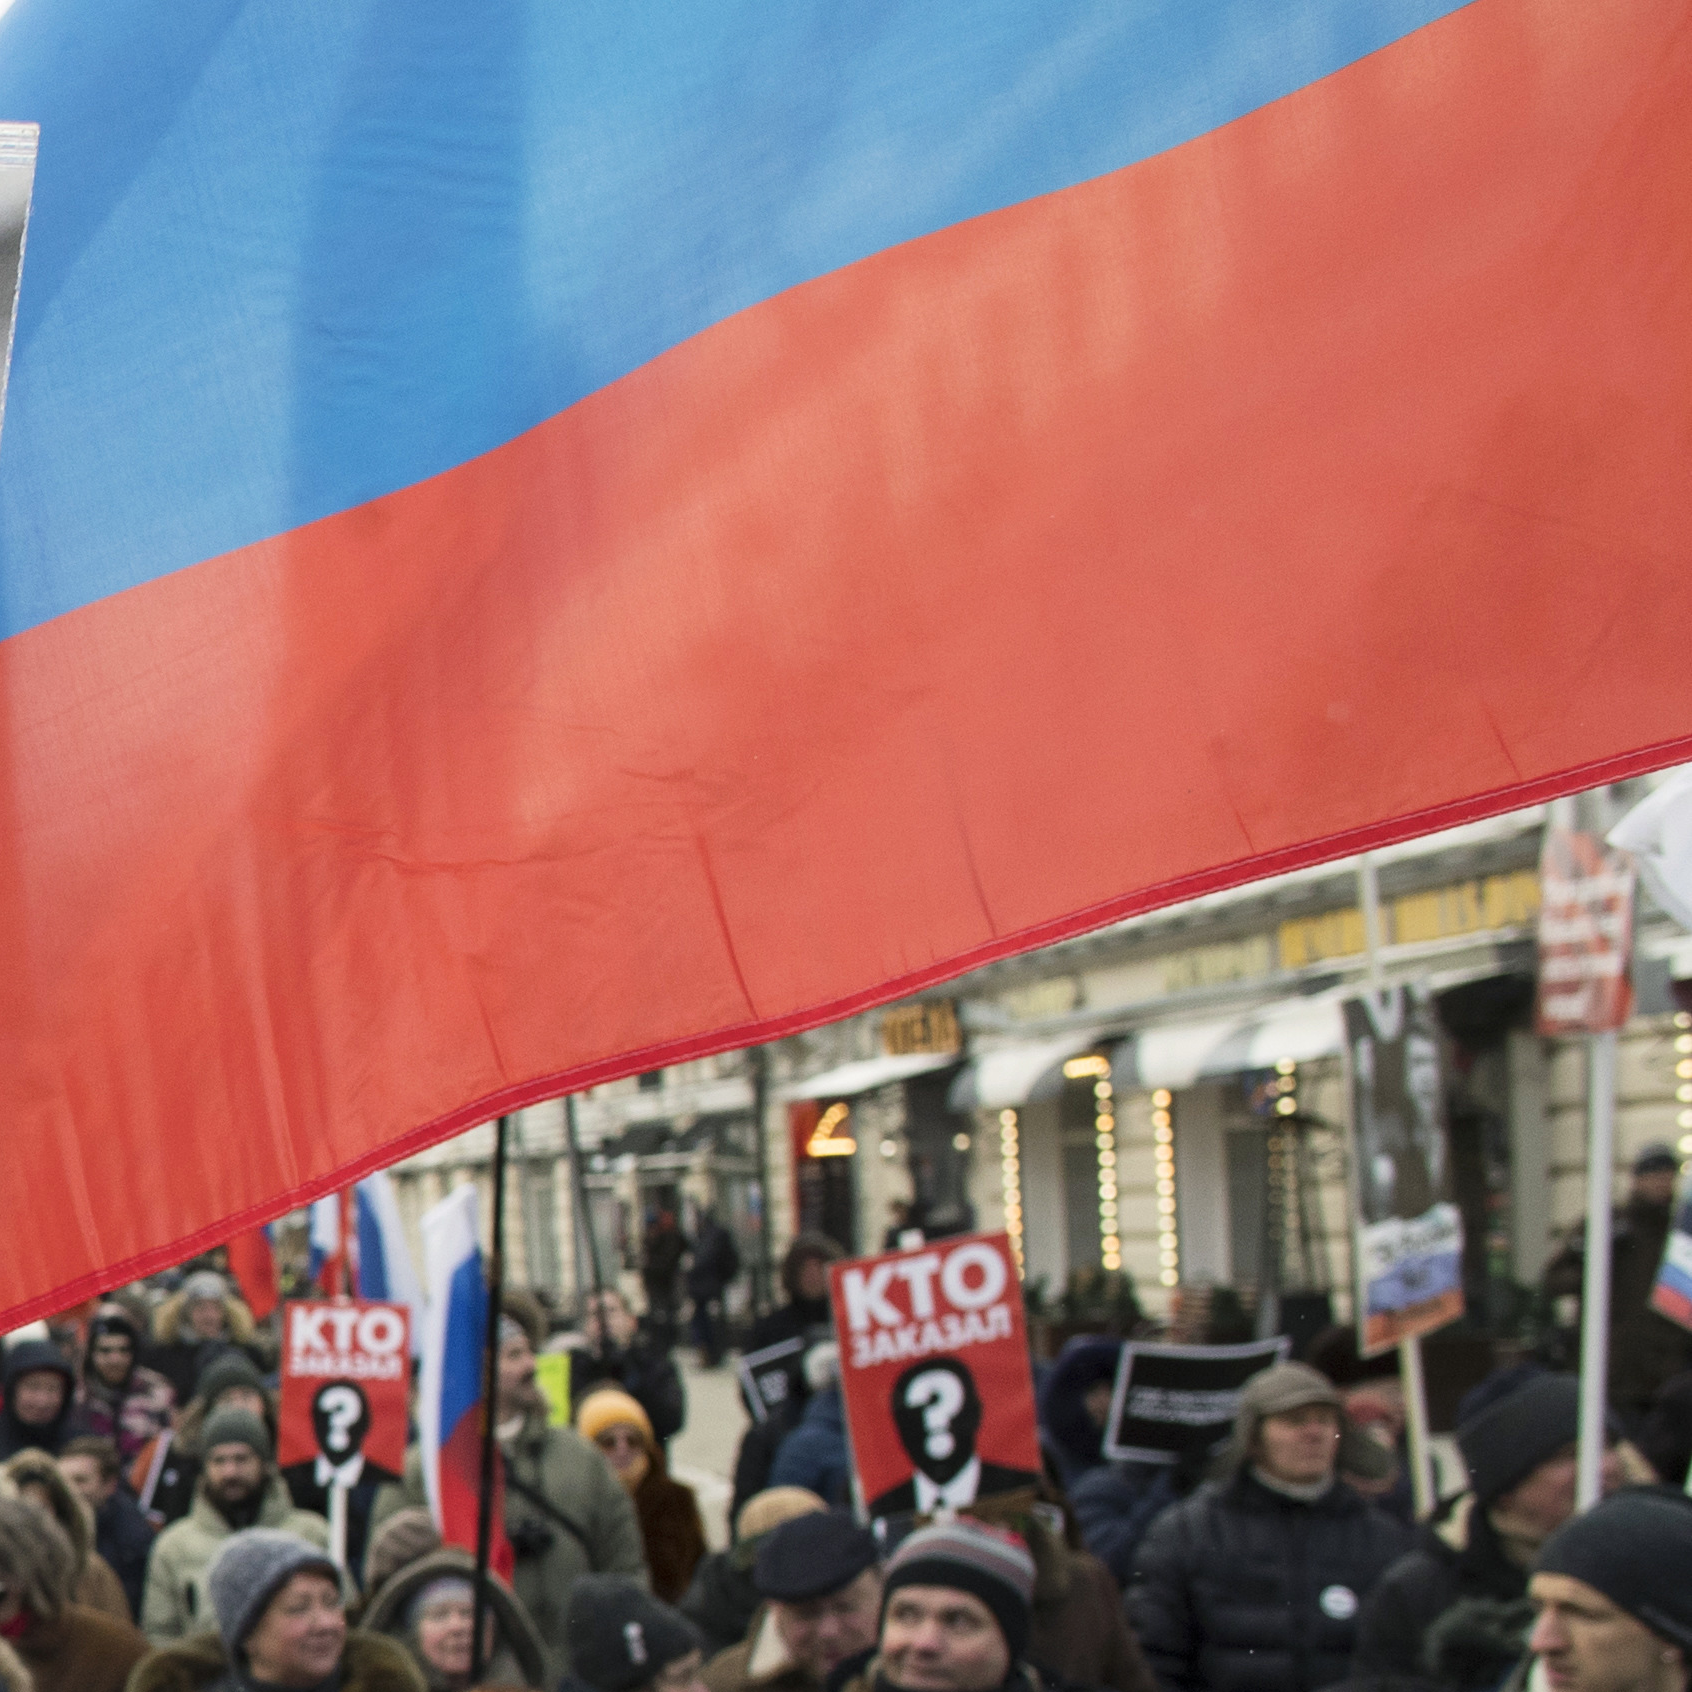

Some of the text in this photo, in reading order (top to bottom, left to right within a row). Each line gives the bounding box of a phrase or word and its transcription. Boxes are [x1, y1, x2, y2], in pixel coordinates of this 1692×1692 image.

[842, 1242, 1008, 1333] КТО
[290, 1306, 405, 1353] КТО
[849, 1302, 1013, 1370] ЗАКАЗАЛ
